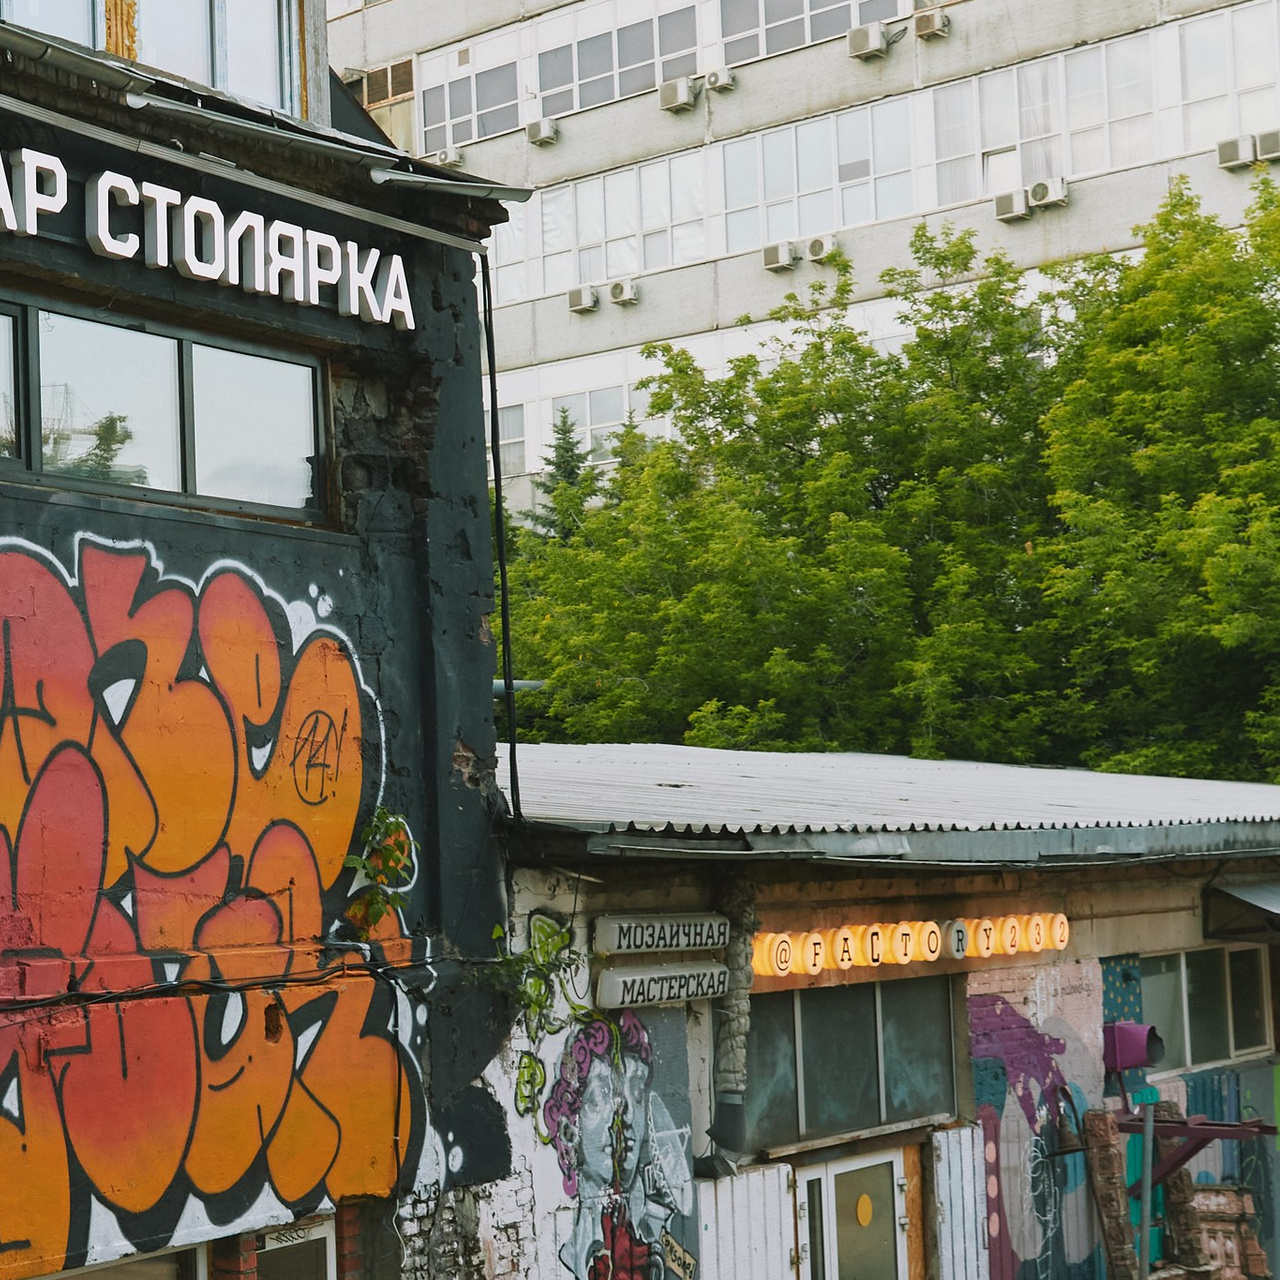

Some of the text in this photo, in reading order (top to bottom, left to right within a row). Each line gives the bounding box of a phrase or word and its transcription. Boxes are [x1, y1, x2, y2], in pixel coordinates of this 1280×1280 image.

[85, 170, 416, 331] СТОЛЯРКА
[616, 922, 728, 950] МОЗАИЧНАЯ
[620, 970, 728, 1006] МАСТЕРСКАЯ
